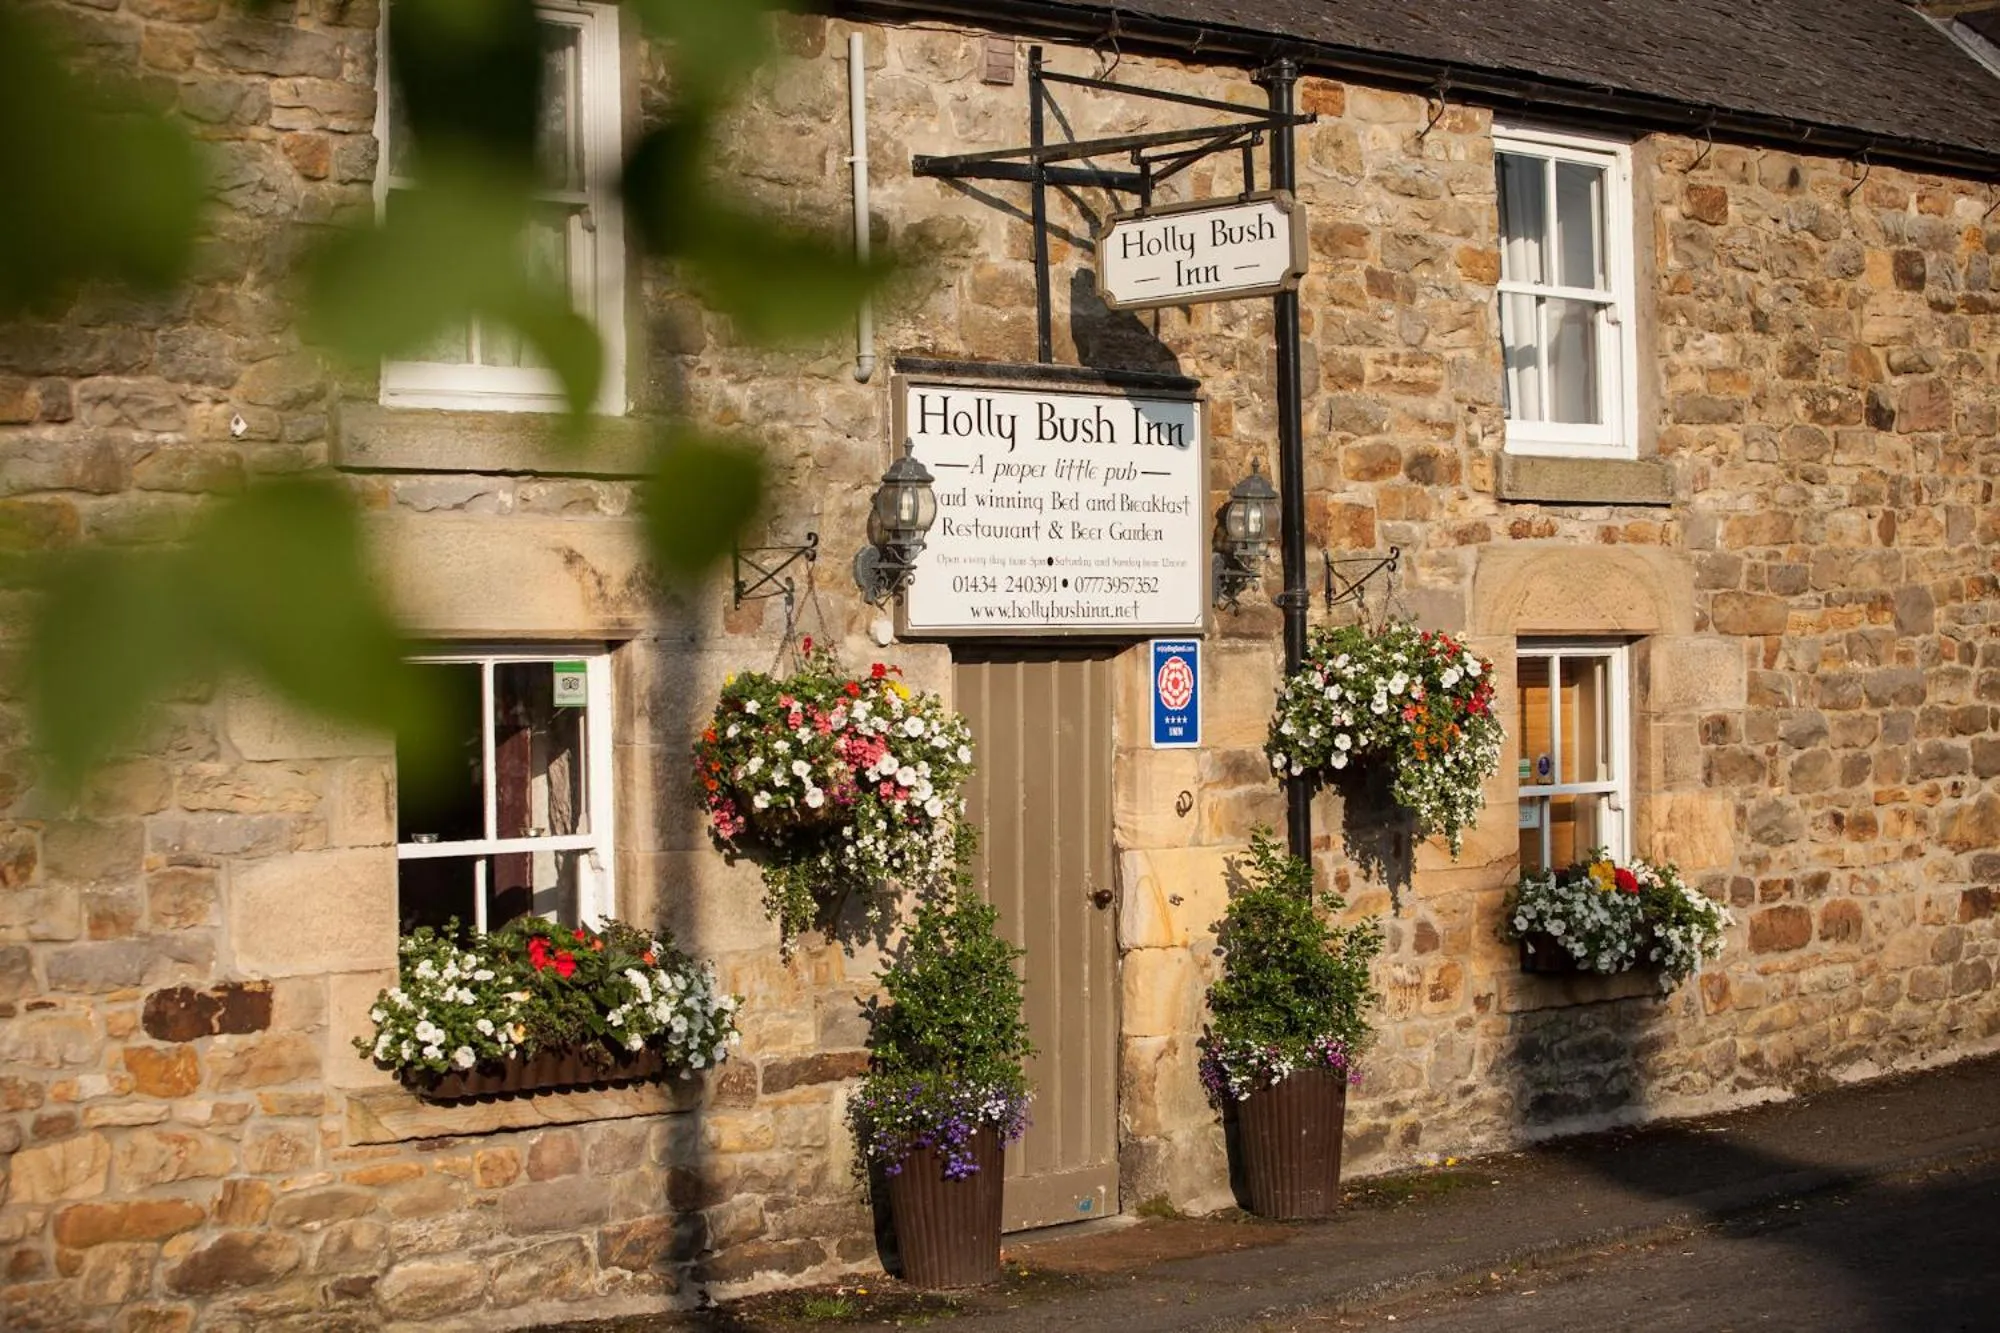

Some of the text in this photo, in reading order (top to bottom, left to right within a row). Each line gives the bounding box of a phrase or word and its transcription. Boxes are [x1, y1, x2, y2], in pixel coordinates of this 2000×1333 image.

[1121, 213, 1276, 260] Holly Bush
[1175, 259, 1221, 287] Inn
[917, 393, 1186, 453] Holly Bush Inn
[970, 454, 1138, 486] A proper little pub
[975, 489, 1044, 514] winning
[1050, 491, 1079, 511] Bed
[1086, 492, 1116, 512] and
[1119, 492, 1191, 517] Breakfast
[941, 517, 1164, 541] Restaurant & Beer Garden
[952, 575, 997, 594] 01434
[1005, 575, 1058, 594] 240391
[970, 600, 1140, 622] www.hollybushinn.net
